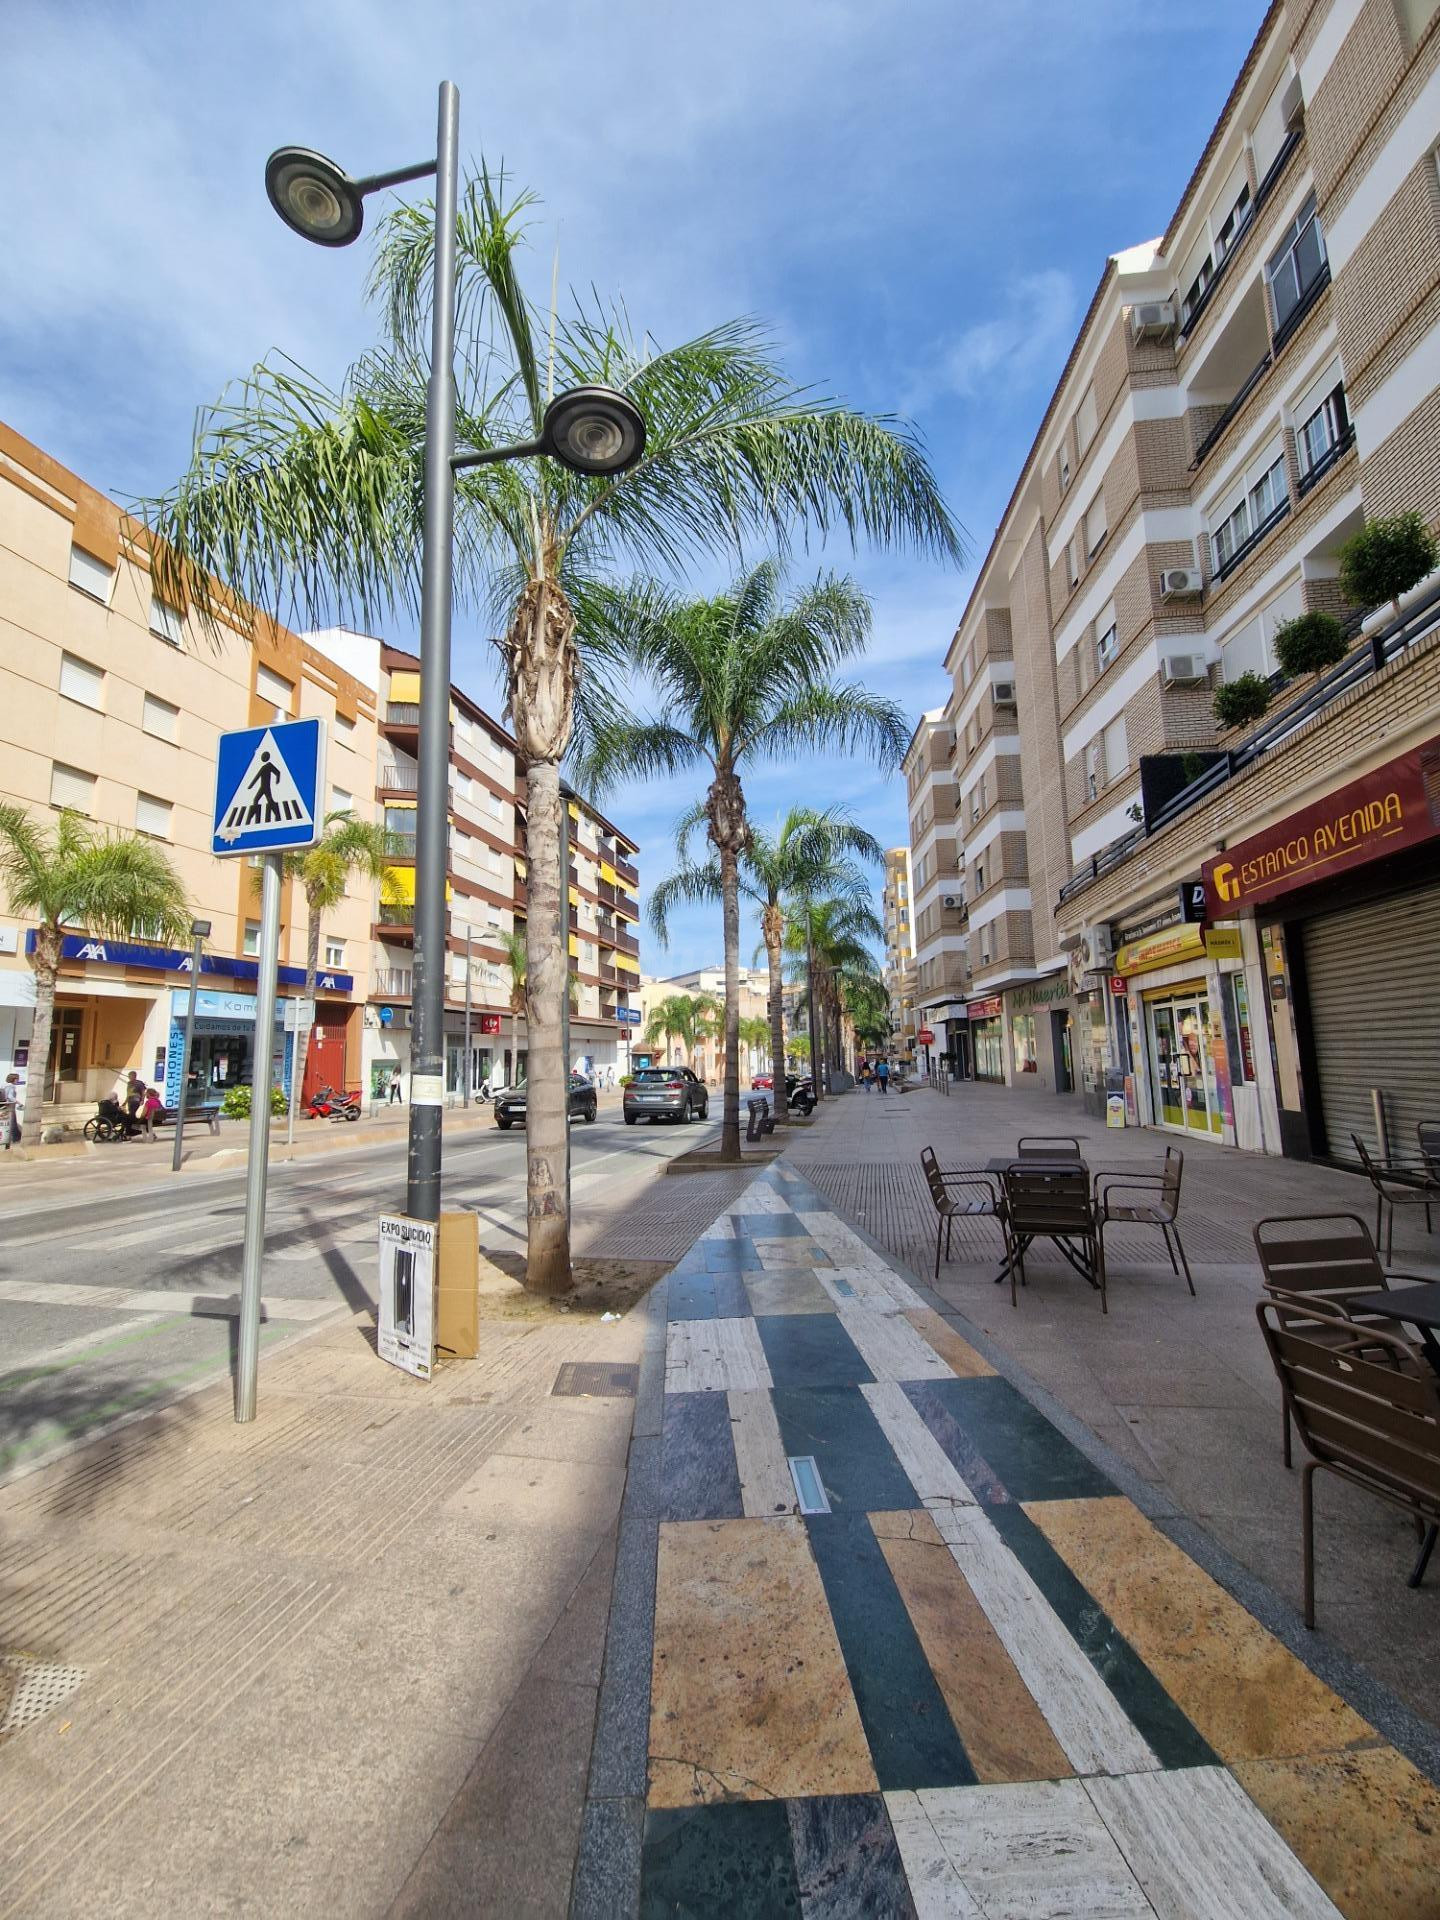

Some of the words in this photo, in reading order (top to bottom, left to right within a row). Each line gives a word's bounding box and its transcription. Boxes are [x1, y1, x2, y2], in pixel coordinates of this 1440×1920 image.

[1241, 836, 1309, 885] ESTANCO
[1314, 793, 1402, 855] AVENIDA
[76, 943, 107, 961] AXA
[319, 976, 336, 989] AXA
[165, 1032, 180, 1108] OLCHONES
[381, 1221, 400, 1236] EXPO
